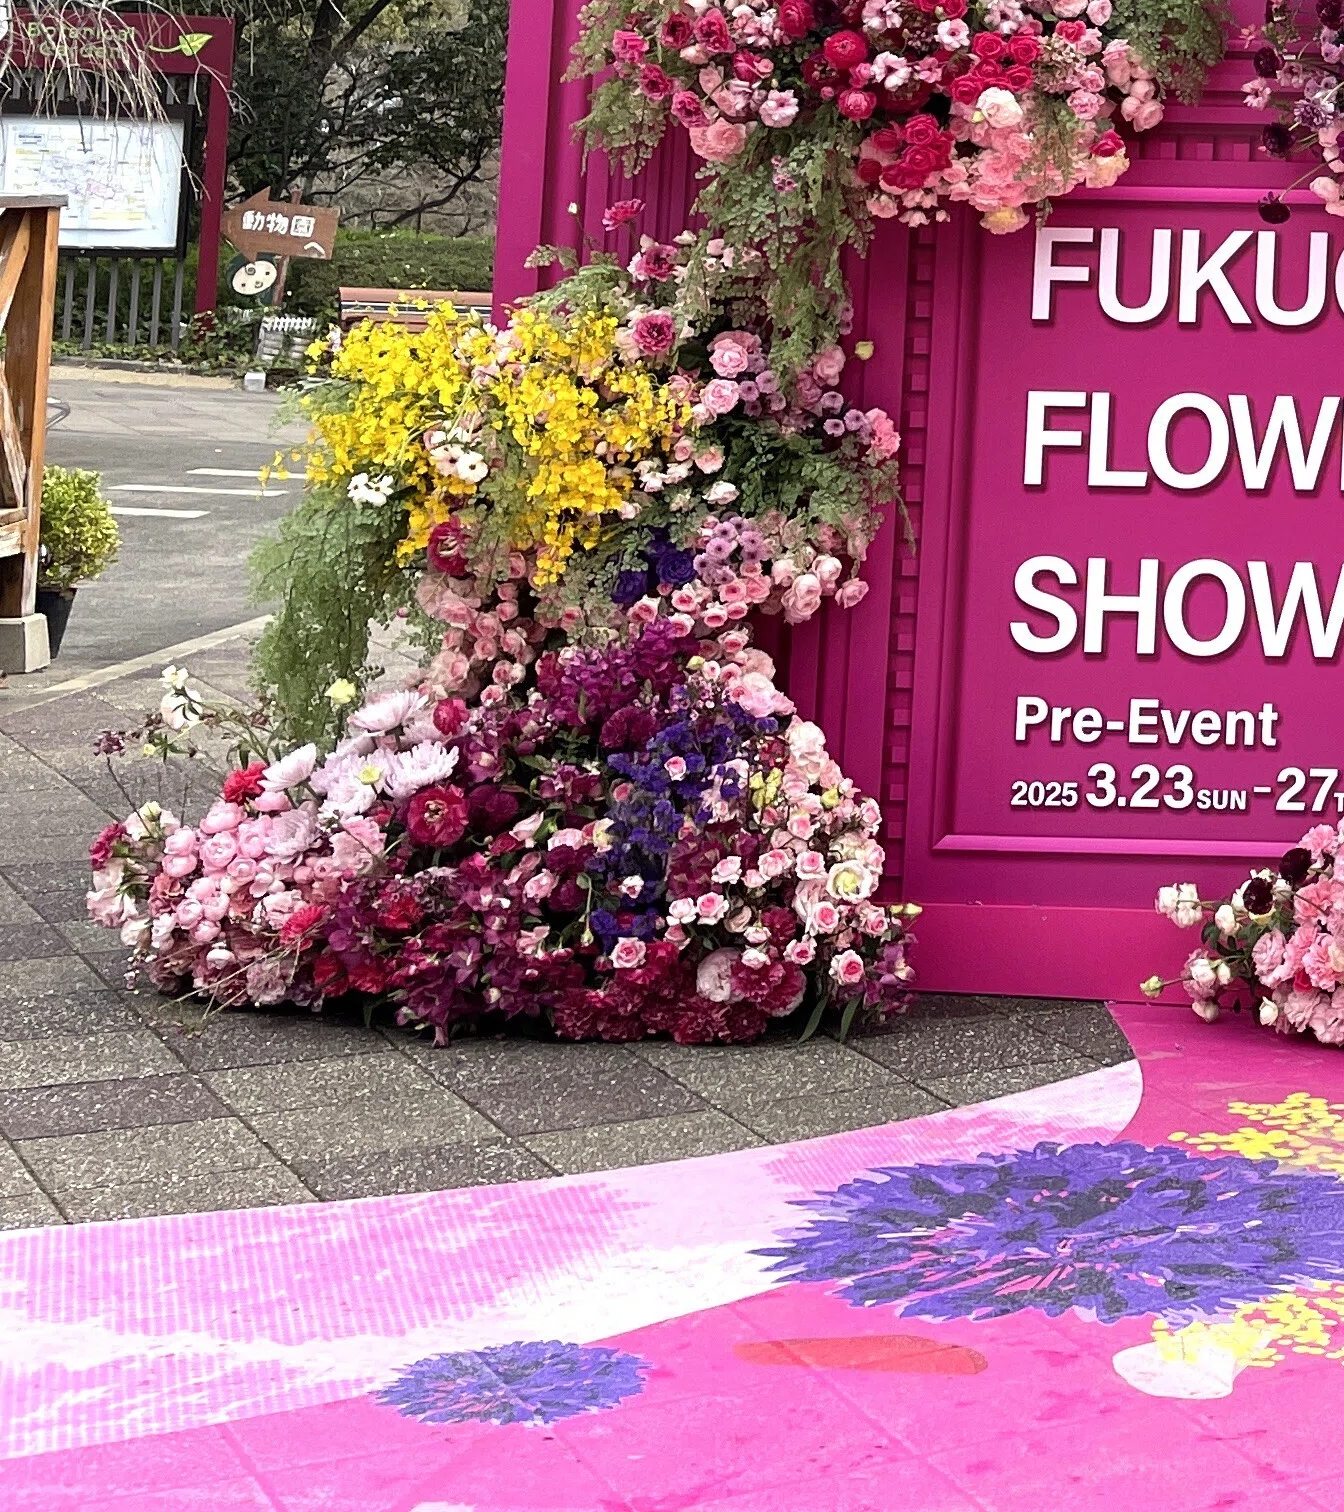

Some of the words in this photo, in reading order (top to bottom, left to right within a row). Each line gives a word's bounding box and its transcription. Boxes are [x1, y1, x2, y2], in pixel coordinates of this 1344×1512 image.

[242, 210, 316, 238] 動物園
[304, 241, 326, 255] へ
[1014, 695, 1279, 747] Pre-Event
[1010, 781, 1078, 807] 2025
